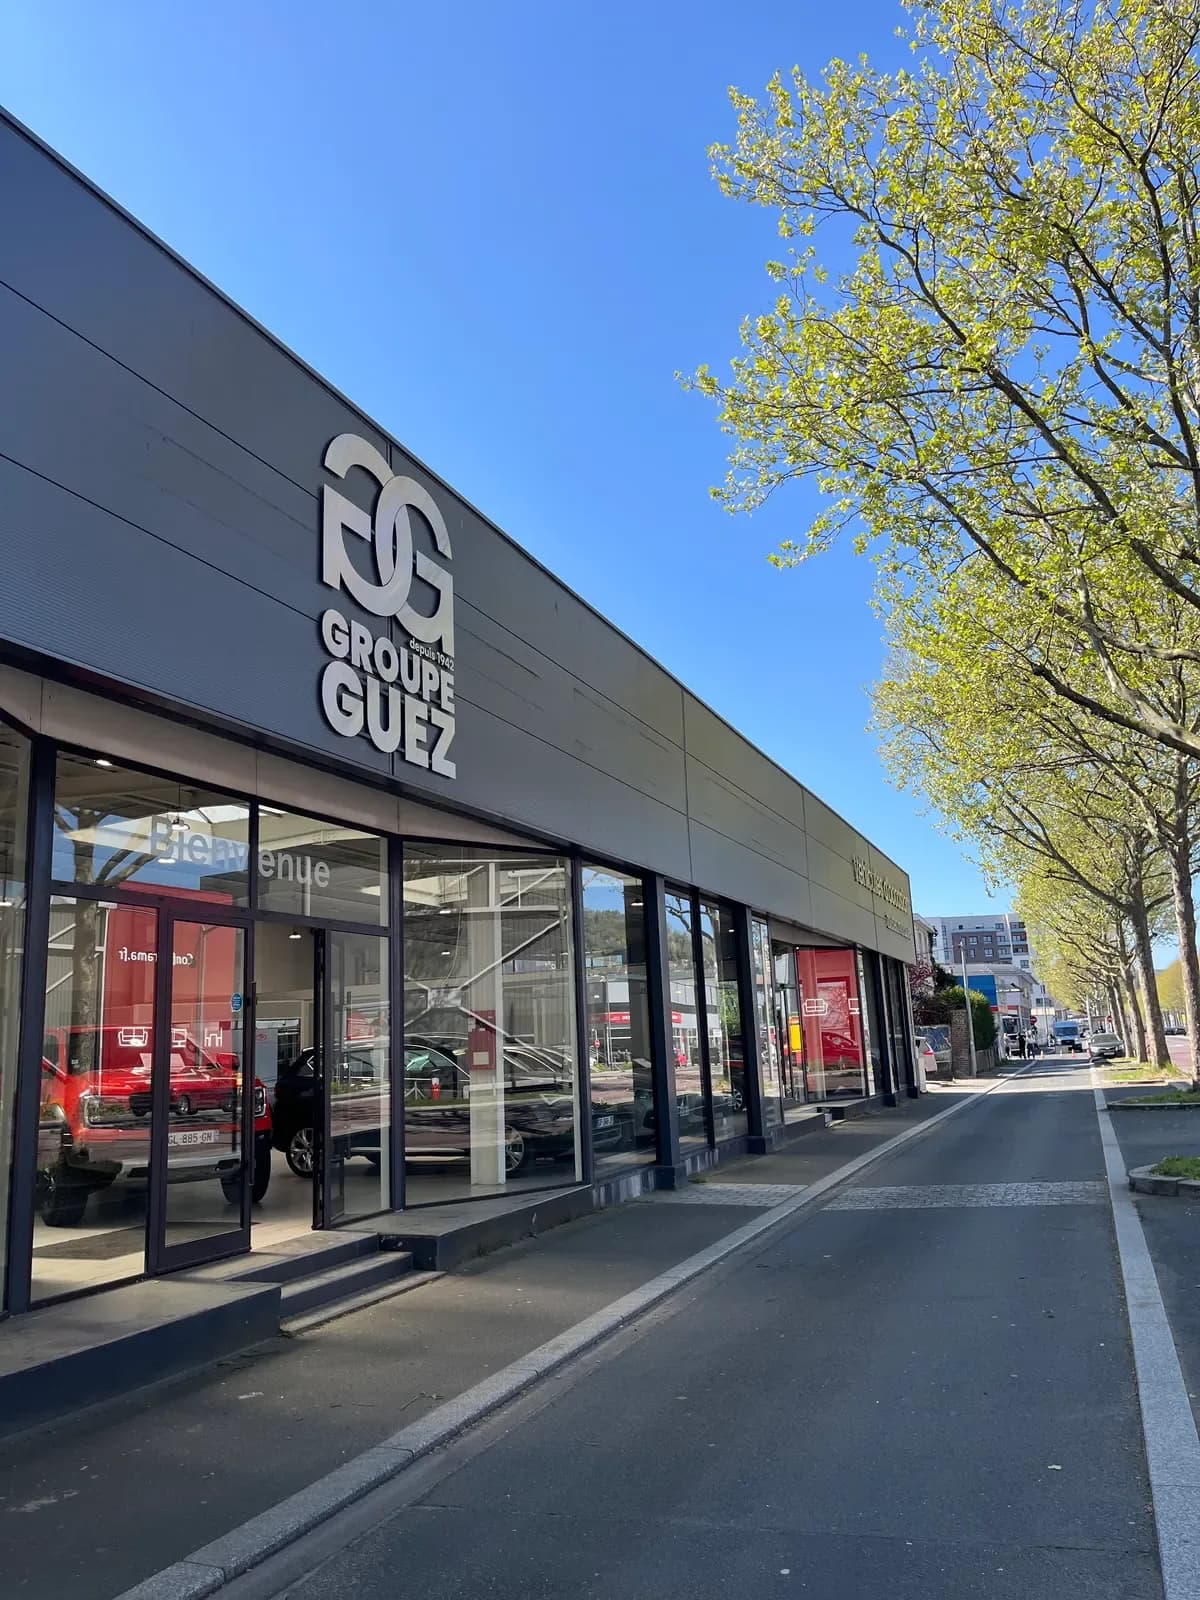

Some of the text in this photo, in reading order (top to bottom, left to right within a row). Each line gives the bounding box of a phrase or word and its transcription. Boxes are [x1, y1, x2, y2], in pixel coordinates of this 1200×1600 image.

[323, 608, 456, 714] GROUPE
[409, 637, 455, 672] depuis 1942
[322, 660, 457, 780] GUEZ
